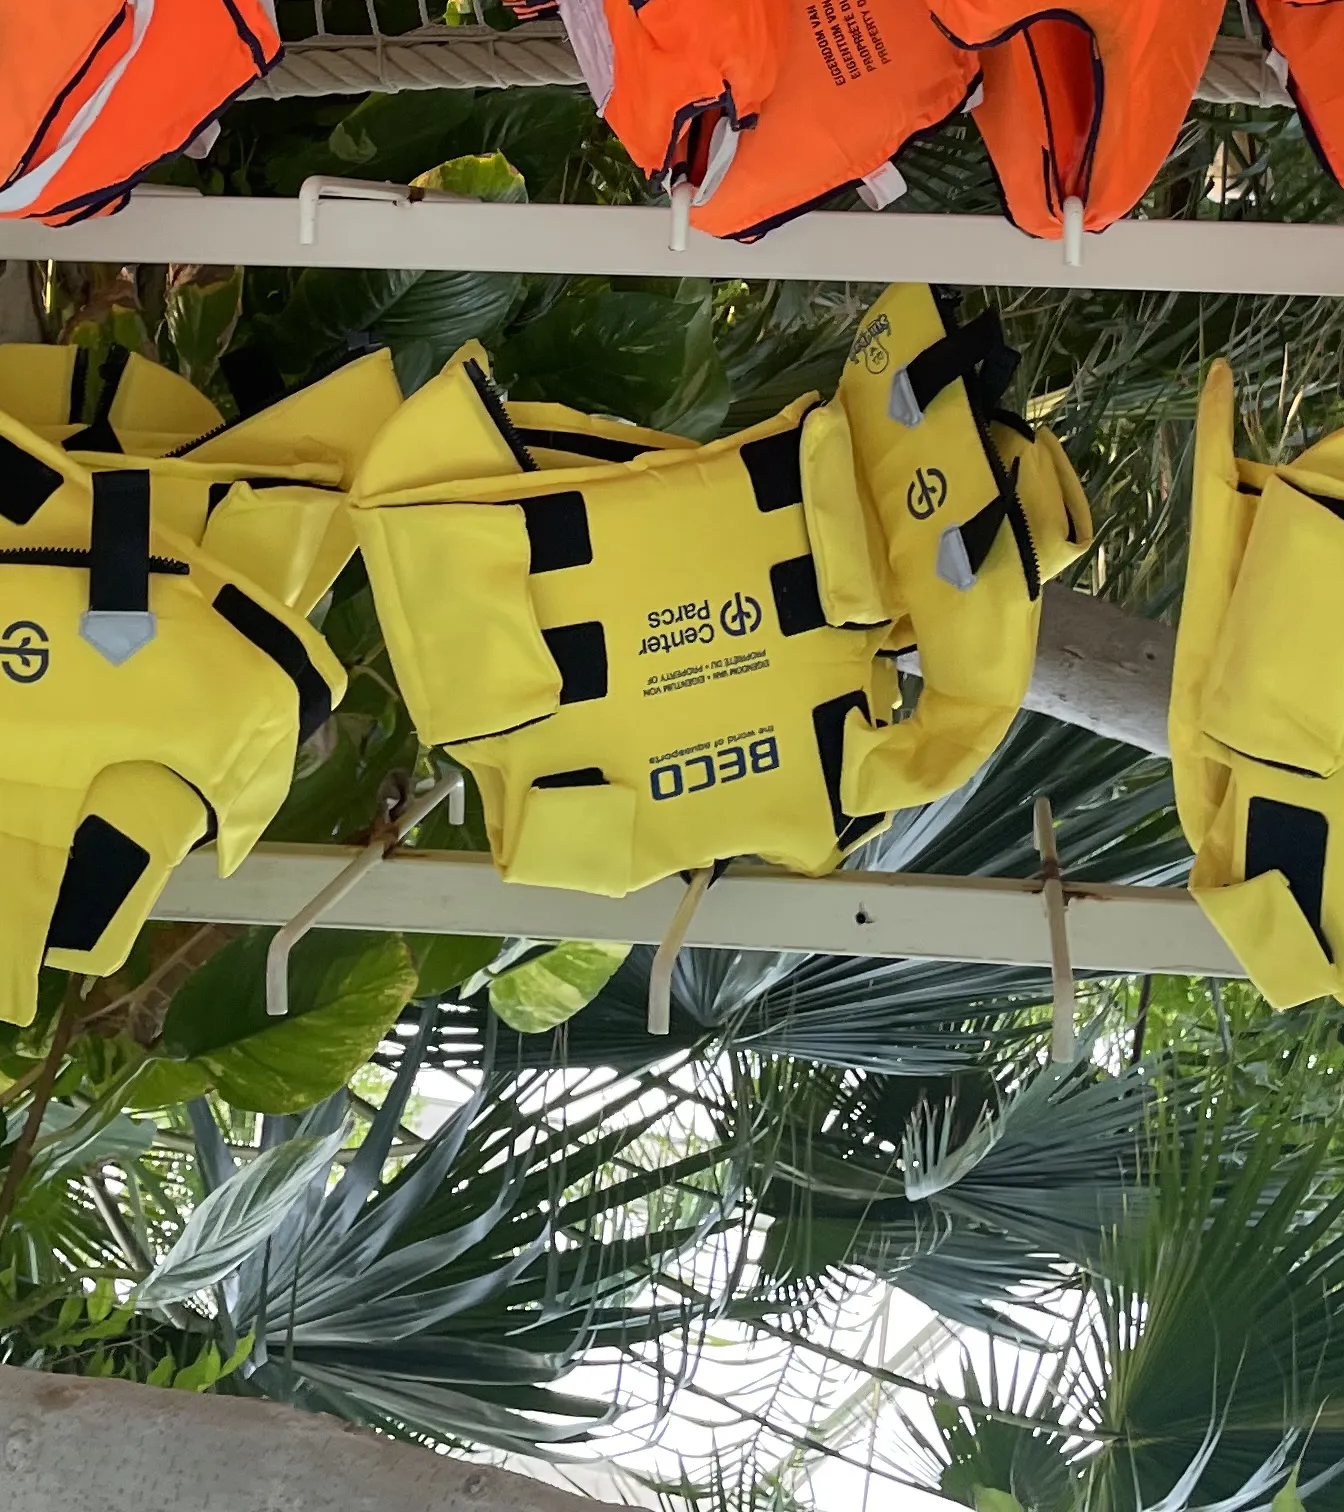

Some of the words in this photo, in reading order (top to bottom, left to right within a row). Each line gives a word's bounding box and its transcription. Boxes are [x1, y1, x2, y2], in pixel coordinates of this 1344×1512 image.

[805, 4, 822, 30] VAN
[860, 9, 892, 65] PROPERTY
[814, 29, 846, 87] EIGENDOM
[830, 23, 861, 80] EIGENTUM
[647, 599, 710, 629] Parcs
[639, 623, 714, 656] Center
[647, 675, 658, 685] OF
[660, 664, 703, 682] PROPERTY
[643, 686, 661, 697] VON
[714, 737, 724, 748] of
[727, 729, 756, 744] world
[758, 725, 774, 735] the
[649, 741, 711, 765] aquasports
[649, 736, 780, 801] BECO
